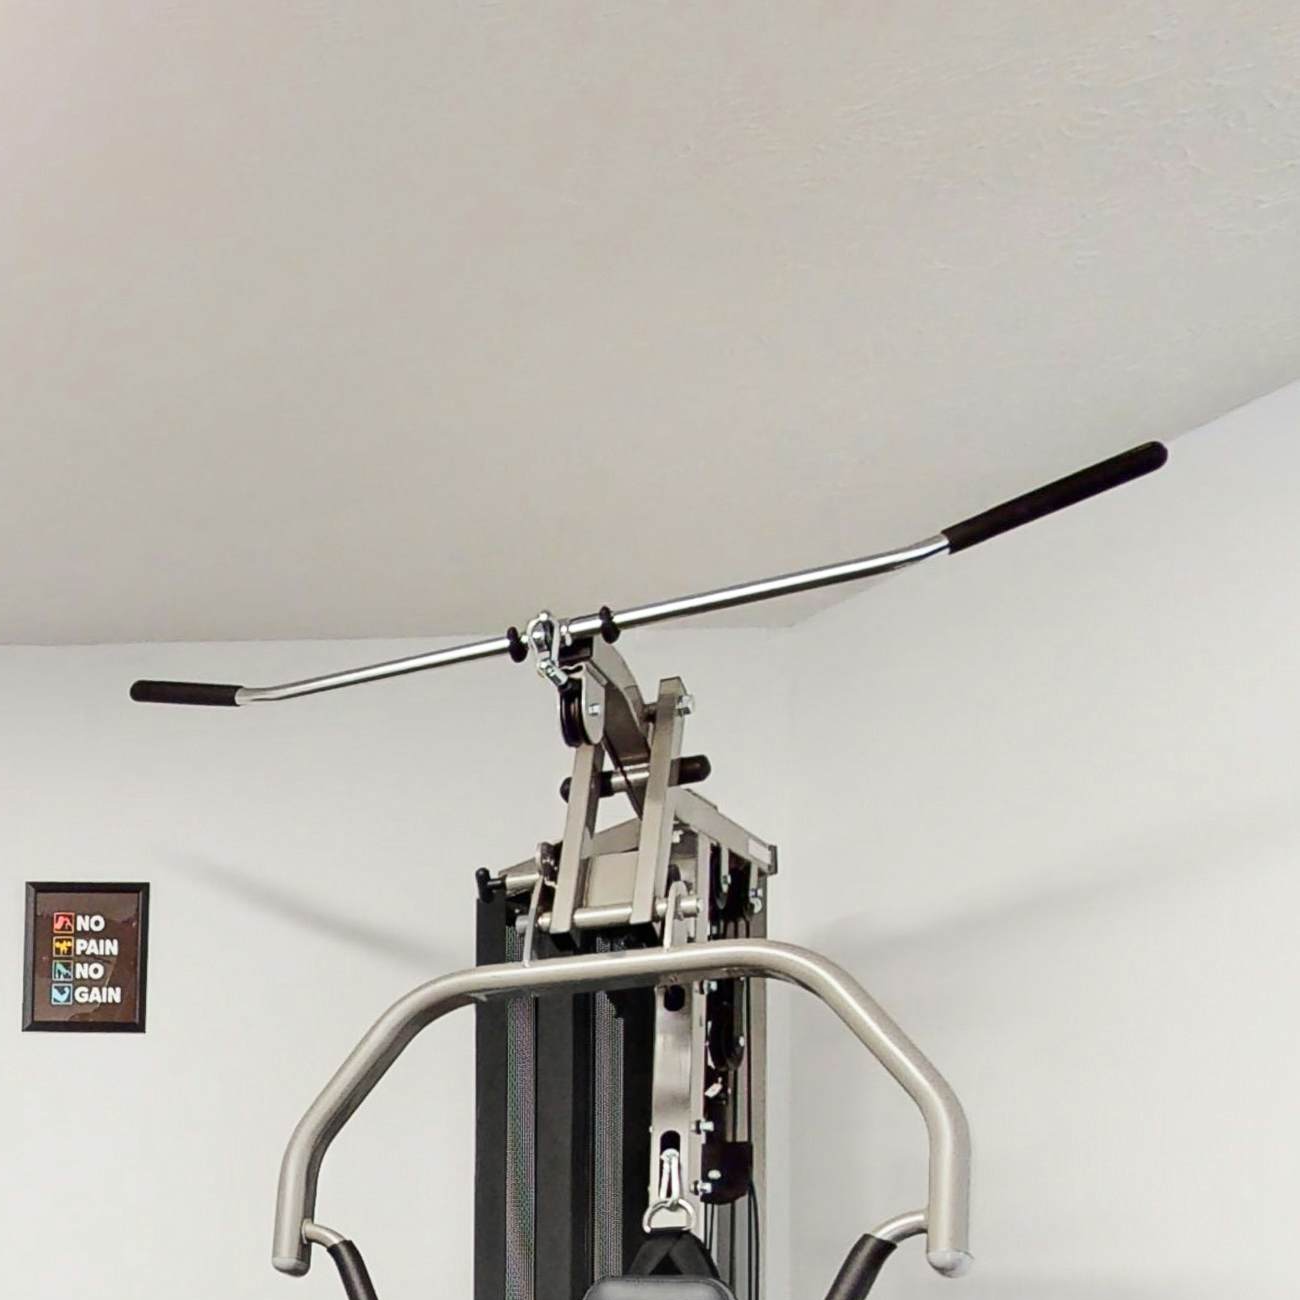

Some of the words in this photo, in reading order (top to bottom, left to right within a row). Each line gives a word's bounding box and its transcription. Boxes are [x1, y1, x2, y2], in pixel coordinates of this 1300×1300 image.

[76, 915, 105, 932] NO
[75, 939, 119, 956] PAIN
[75, 963, 105, 980] NO
[74, 986, 122, 1003] GAIN
